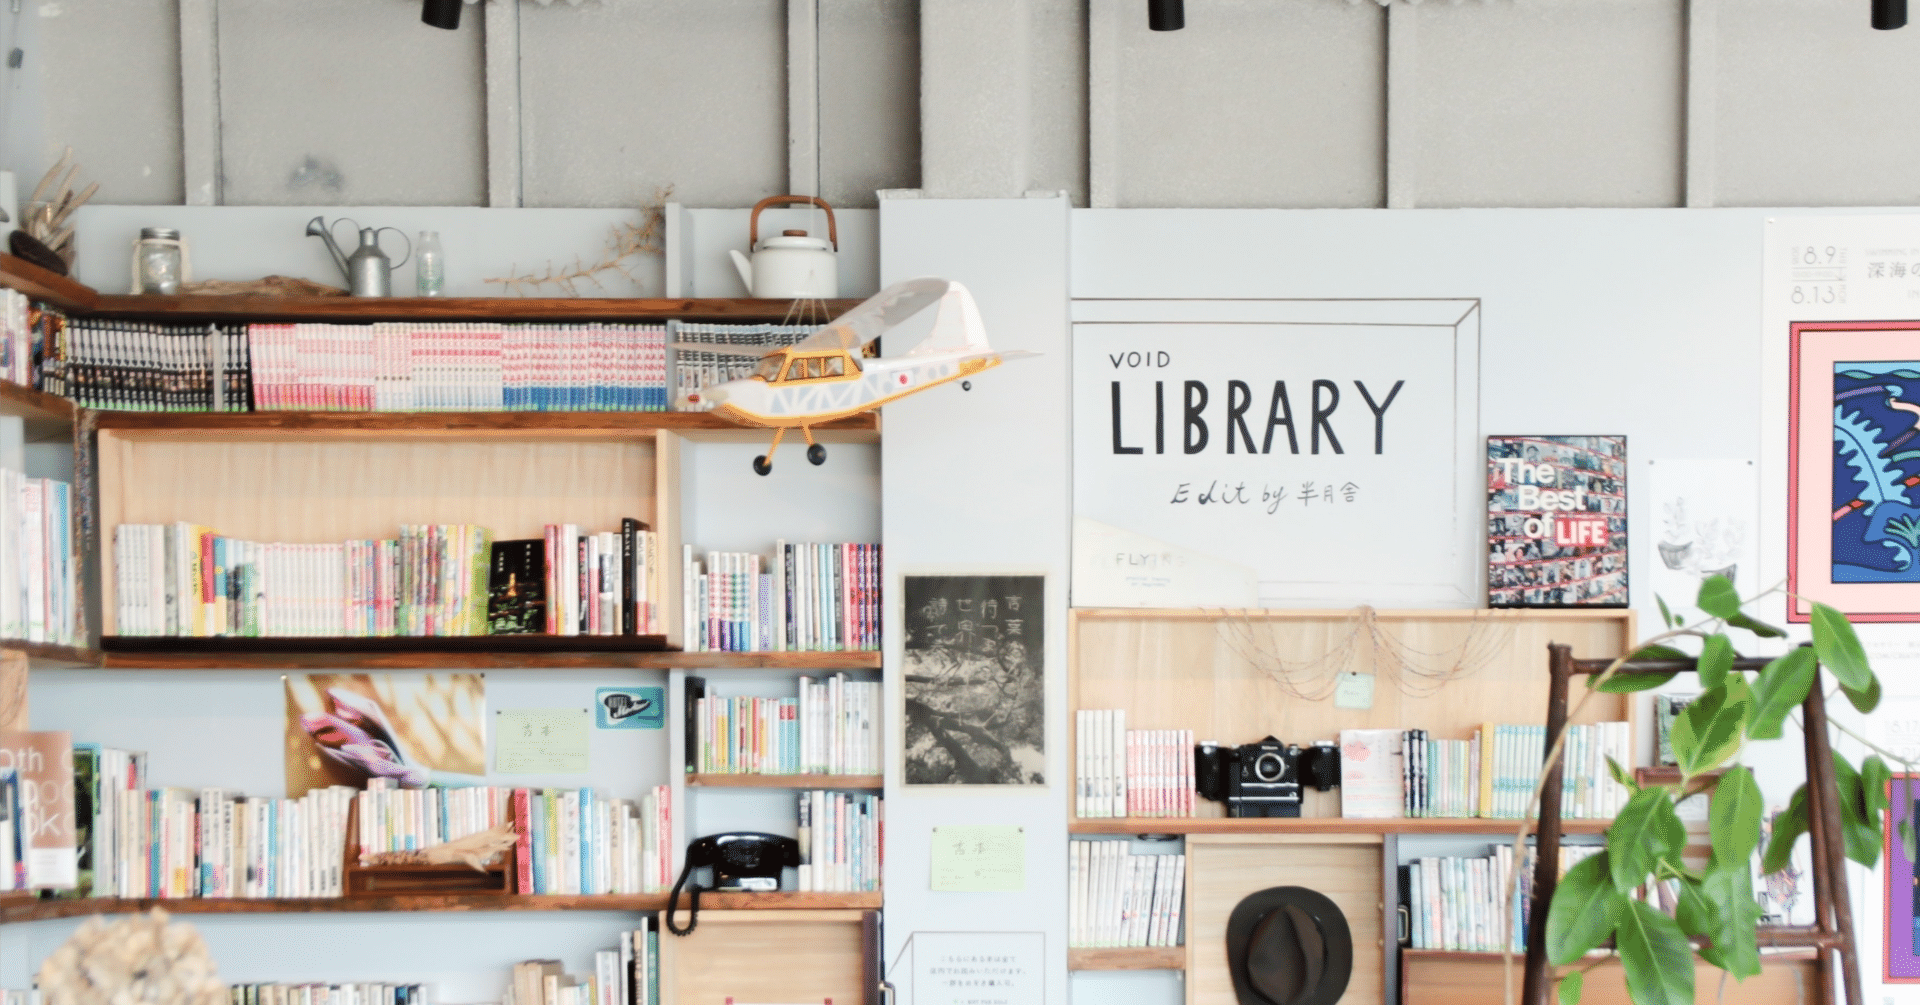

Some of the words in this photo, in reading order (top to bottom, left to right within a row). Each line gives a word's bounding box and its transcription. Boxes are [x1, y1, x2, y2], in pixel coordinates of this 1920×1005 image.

[1803, 245, 1836, 265] 8.9
[1791, 285, 1835, 304] 8.13
[1109, 350, 1171, 370] VOID
[1111, 379, 1406, 456] LIBRARY
[1496, 457, 1555, 485] The
[1170, 480, 1250, 504] Edit
[1262, 483, 1289, 515] by
[1518, 484, 1587, 511] Best
[1523, 511, 1555, 539] of
[1556, 520, 1606, 545] LIFE
